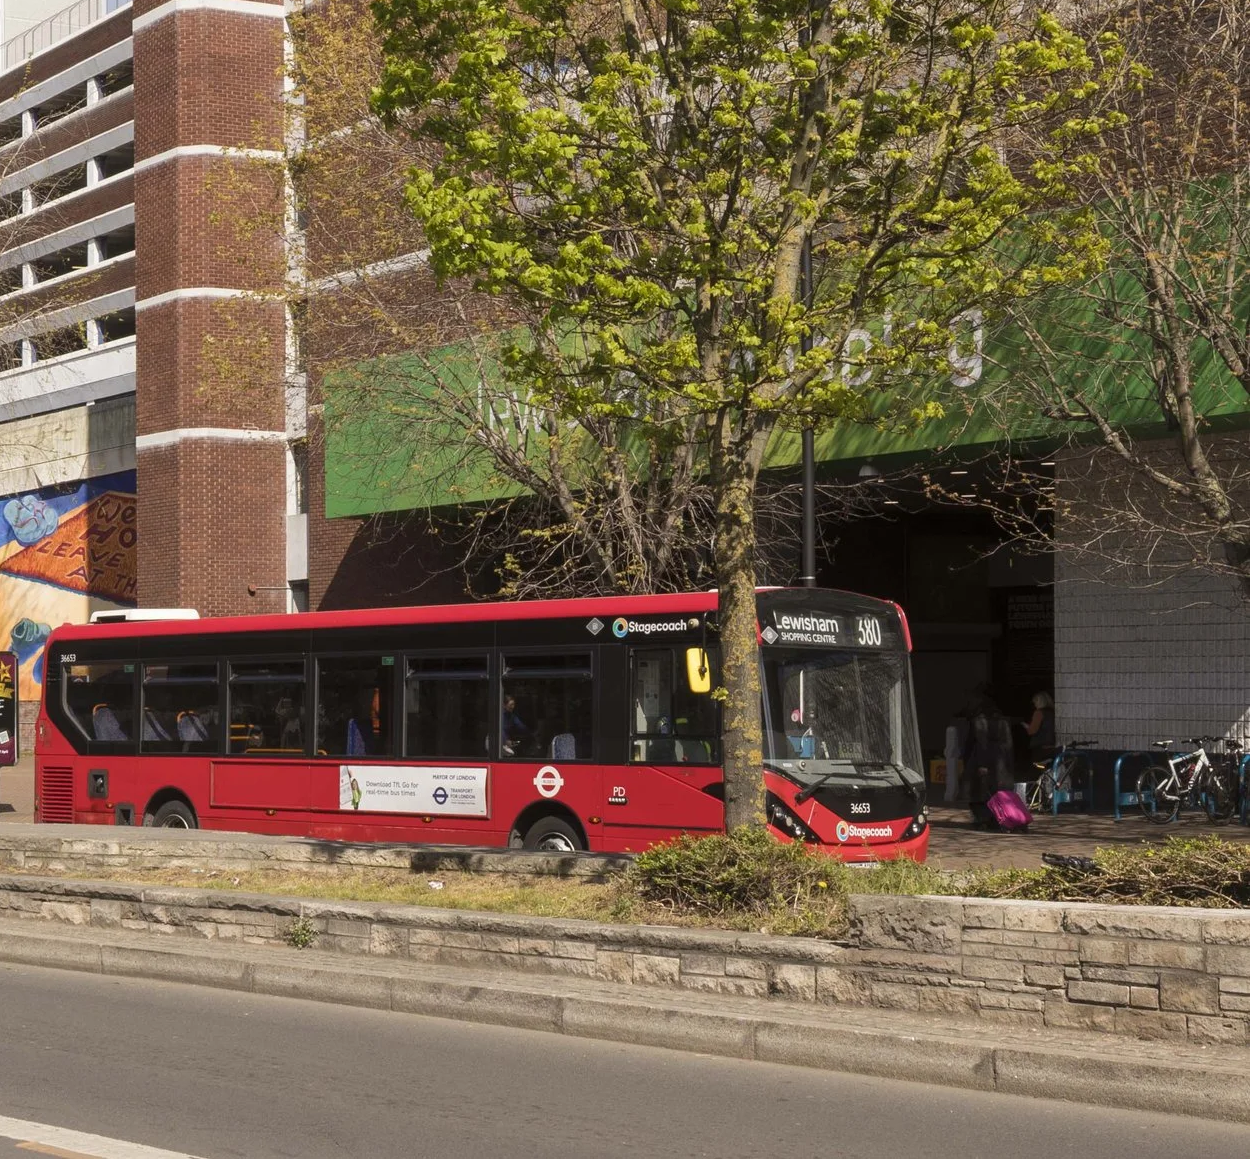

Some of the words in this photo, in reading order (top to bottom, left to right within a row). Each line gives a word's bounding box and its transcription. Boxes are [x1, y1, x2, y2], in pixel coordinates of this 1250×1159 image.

[37, 541, 125, 568] LEAVE
[66, 566, 104, 586] AT
[628, 619, 687, 634] Stagecoach
[773, 609, 839, 633] Lewisham
[781, 632, 811, 642] SHOPPING
[812, 634, 837, 644] CENTRE
[857, 617, 882, 646] 380
[60, 654, 76, 662] 36653
[613, 786, 625, 797] PD
[850, 803, 870, 814] 36653
[849, 825, 892, 839] Stagecoach
